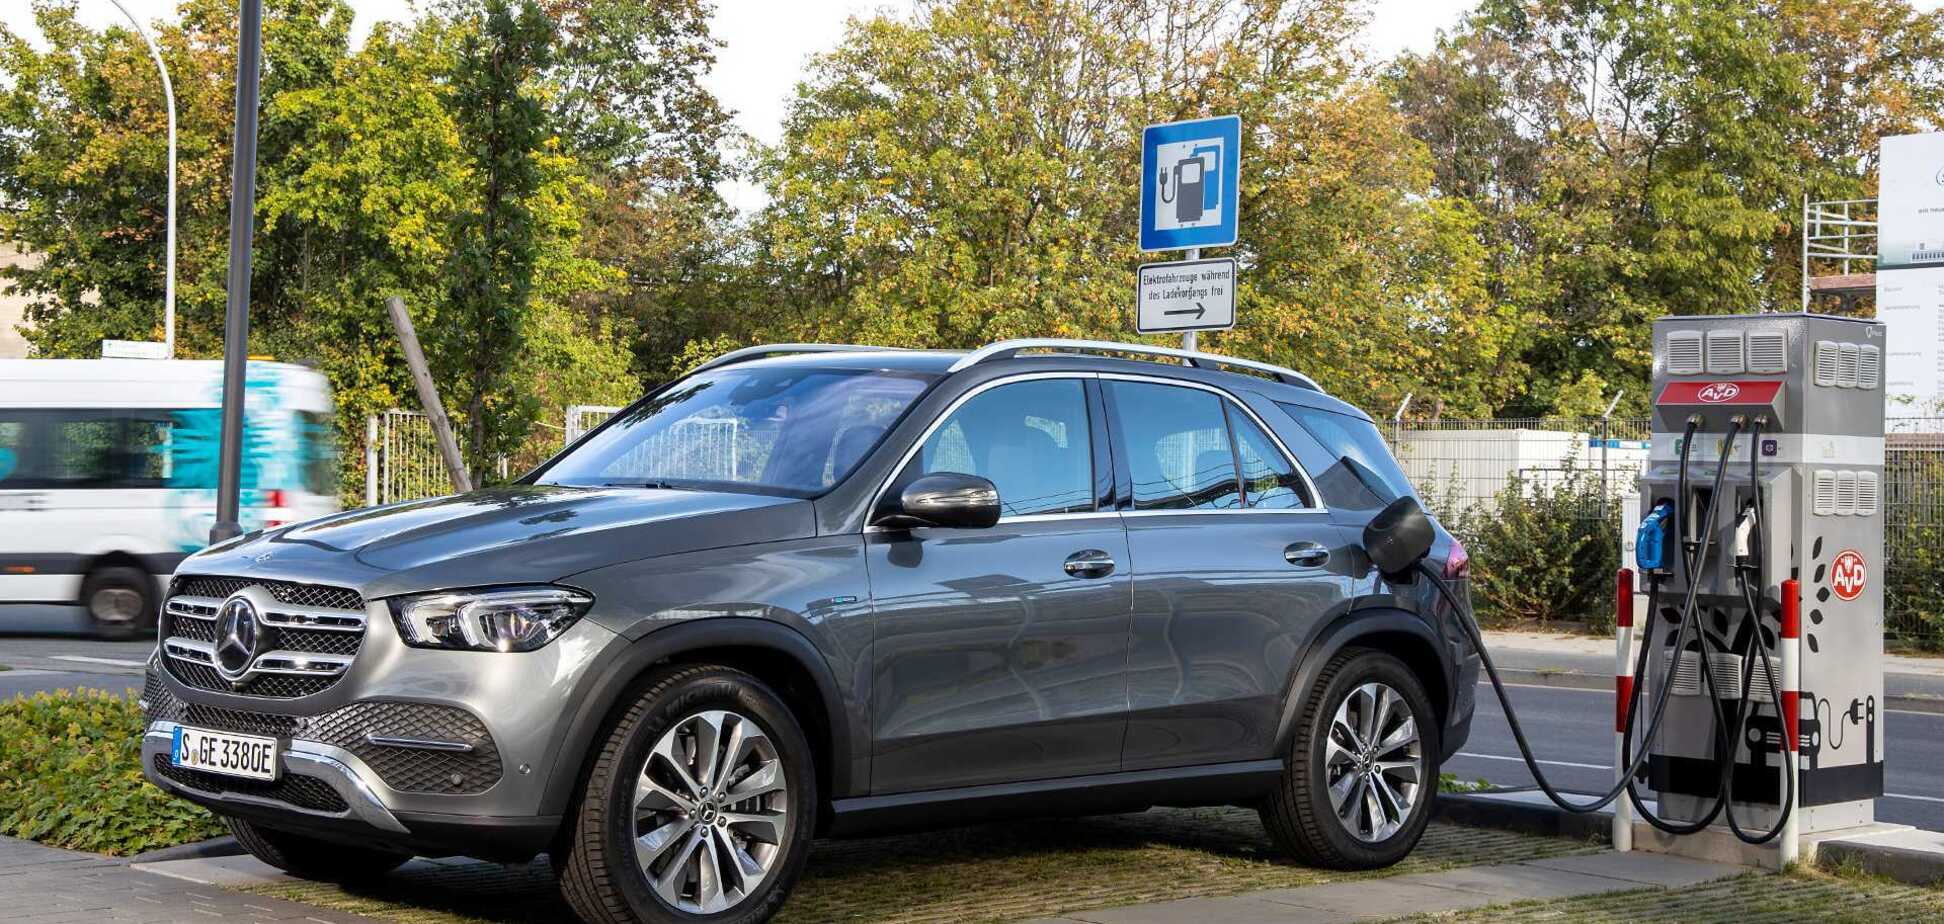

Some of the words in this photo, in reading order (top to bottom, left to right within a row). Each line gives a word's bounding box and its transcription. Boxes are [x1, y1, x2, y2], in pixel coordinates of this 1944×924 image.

[1143, 272, 1198, 286] Elektrofahrzeuge
[1201, 269, 1230, 281] während
[1148, 290, 1160, 300] des
[1162, 287, 1208, 300] Ladevorgangs
[1211, 285, 1224, 297] frei
[181, 733, 190, 761] S
[199, 736, 217, 766] GE
[220, 739, 272, 773] 3380E
